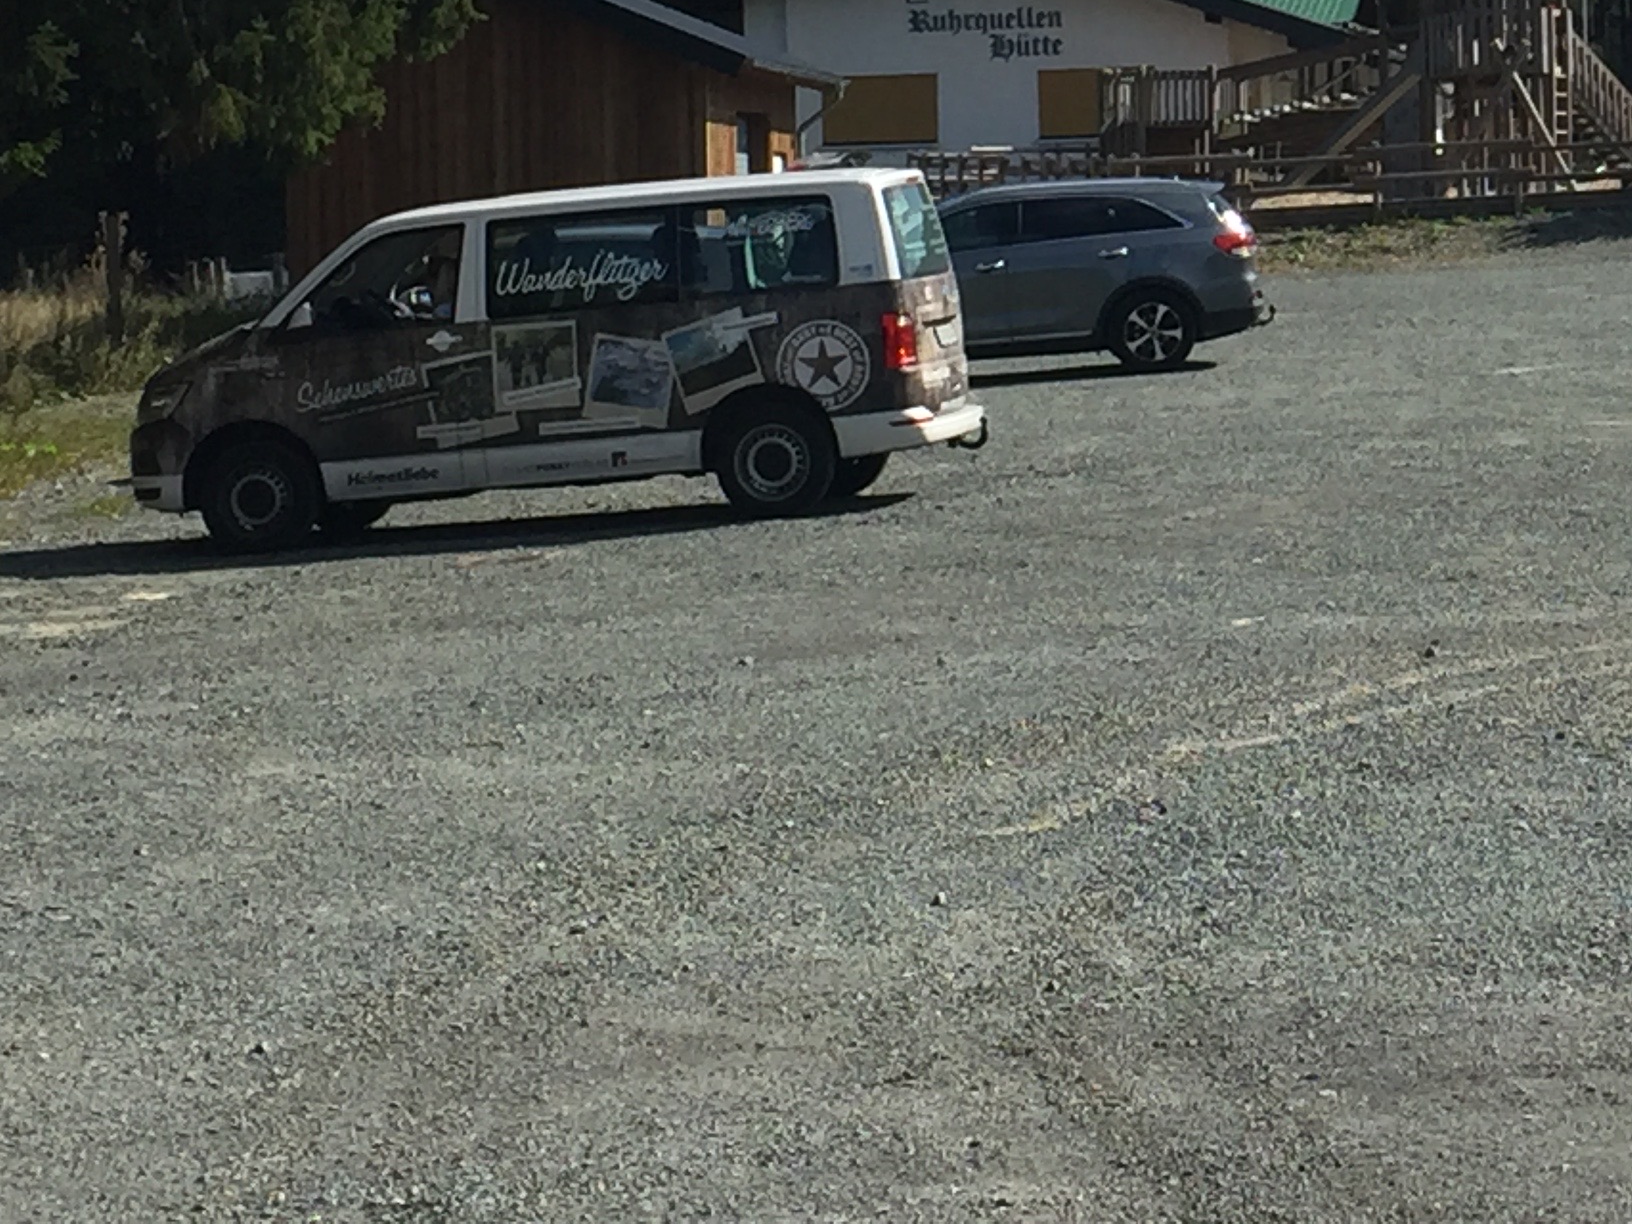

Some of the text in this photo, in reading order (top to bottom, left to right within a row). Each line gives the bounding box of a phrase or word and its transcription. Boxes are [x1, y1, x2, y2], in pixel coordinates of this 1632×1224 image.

[908, 7, 1063, 35] Ruhrquellen
[989, 32, 1064, 63] Hütte
[495, 248, 670, 302] Wanderflitzer
